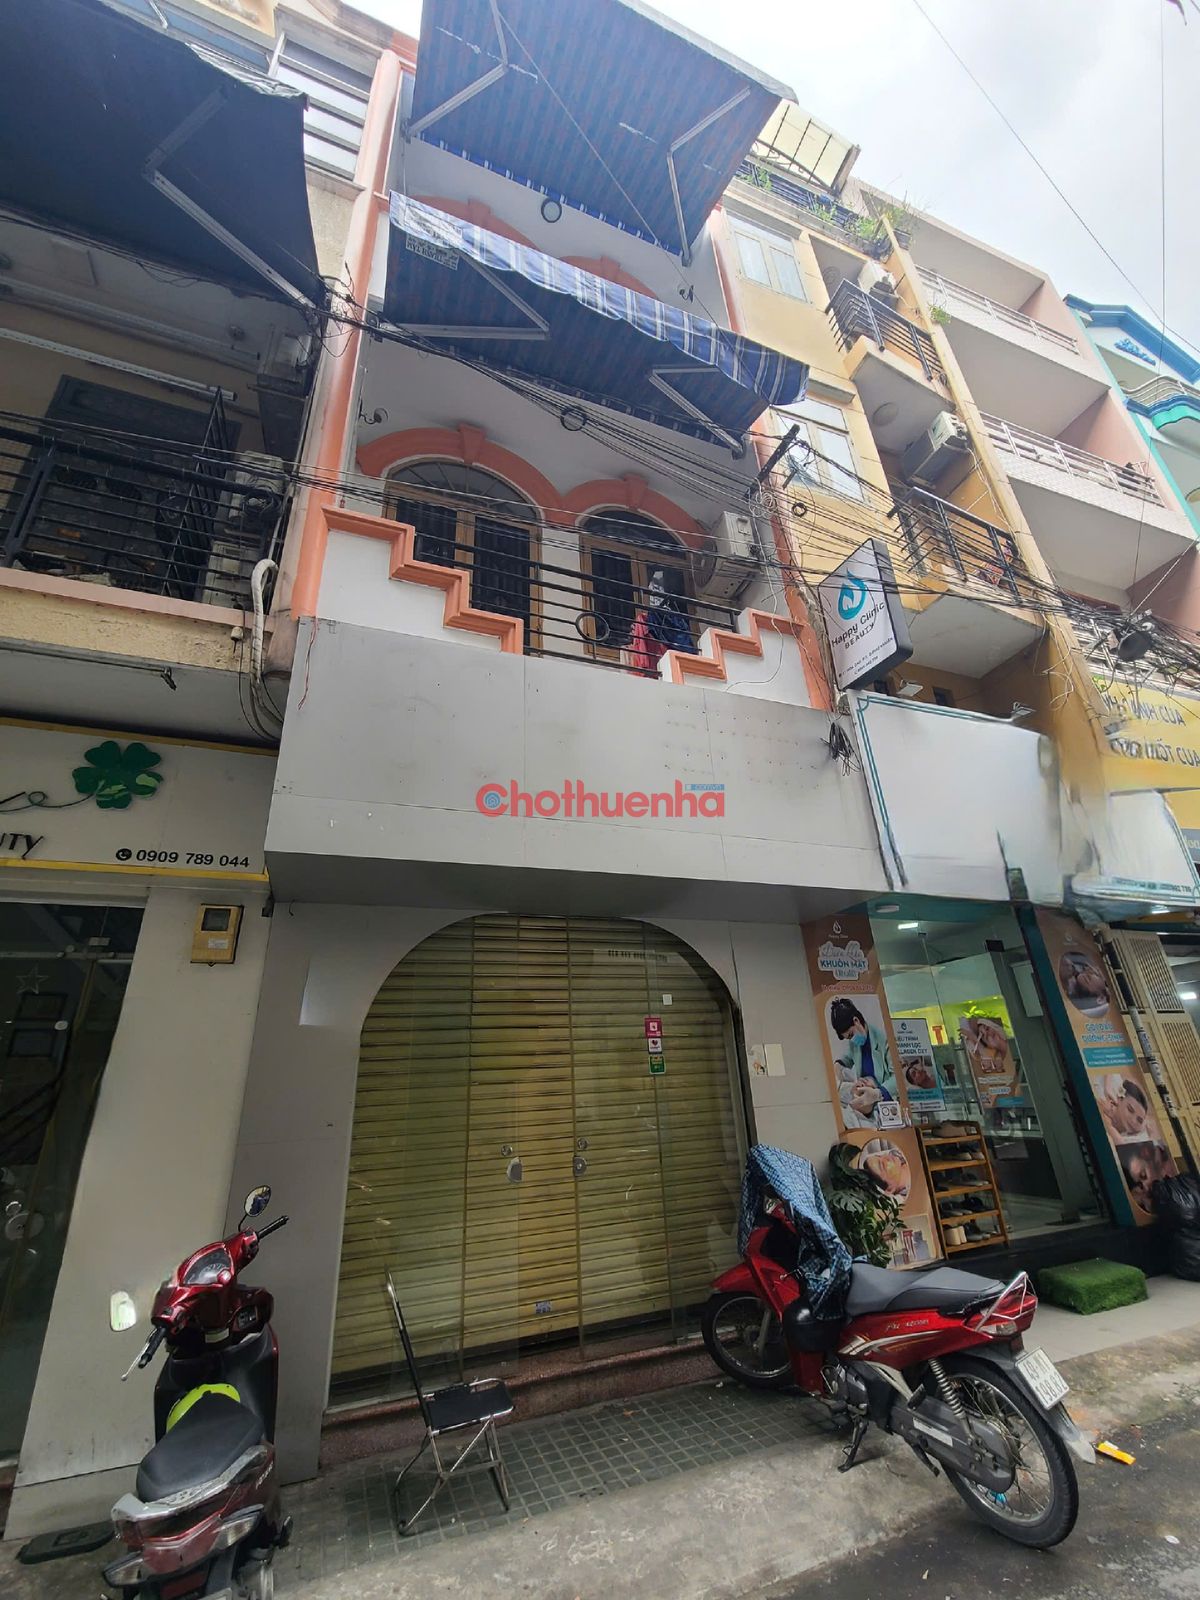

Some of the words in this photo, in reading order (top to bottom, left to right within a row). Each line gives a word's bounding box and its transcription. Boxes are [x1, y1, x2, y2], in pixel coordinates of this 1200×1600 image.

[831, 622, 858, 647] Happy
[860, 602, 885, 625] Clinic
[844, 622, 874, 650] BEAUTY
[136, 849, 179, 863] 0909
[185, 852, 214, 865] 789
[219, 855, 250, 868] 044
[819, 957, 849, 969] KHUÔN
